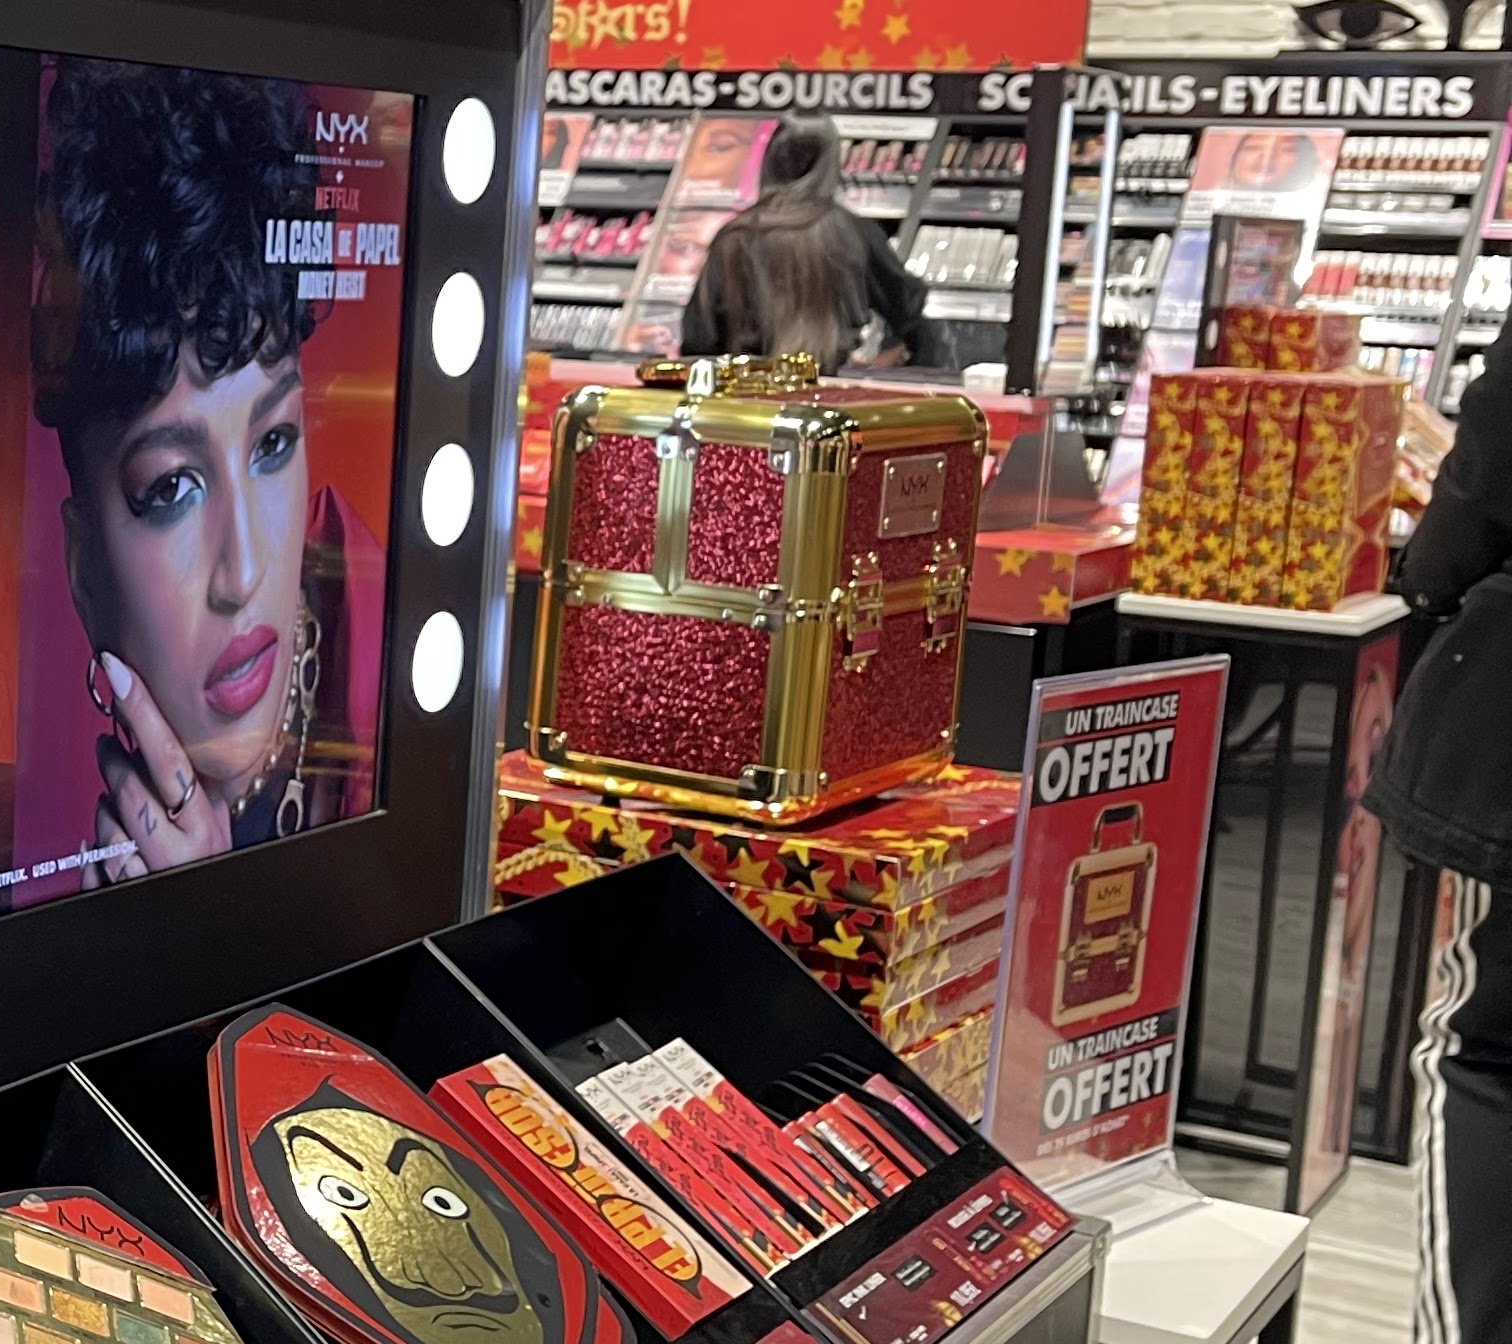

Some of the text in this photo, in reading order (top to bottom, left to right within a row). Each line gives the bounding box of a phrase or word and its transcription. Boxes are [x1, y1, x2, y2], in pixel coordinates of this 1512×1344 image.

[315, 111, 369, 145] NYX
[314, 186, 360, 212] NETFLIX
[265, 219, 286, 264] LA
[288, 219, 334, 264] CASA
[355, 223, 401, 266] PAPEL
[1065, 692, 1180, 737] UN TRAINCASE
[1038, 726, 1176, 805] OFFERT
[32, 864, 57, 878] USED
[58, 853, 82, 871] WITH
[1048, 1015, 1159, 1071] UN TRAINCASE
[1043, 1042, 1174, 1130] OFFERT
[57, 1204, 145, 1257] NYX
